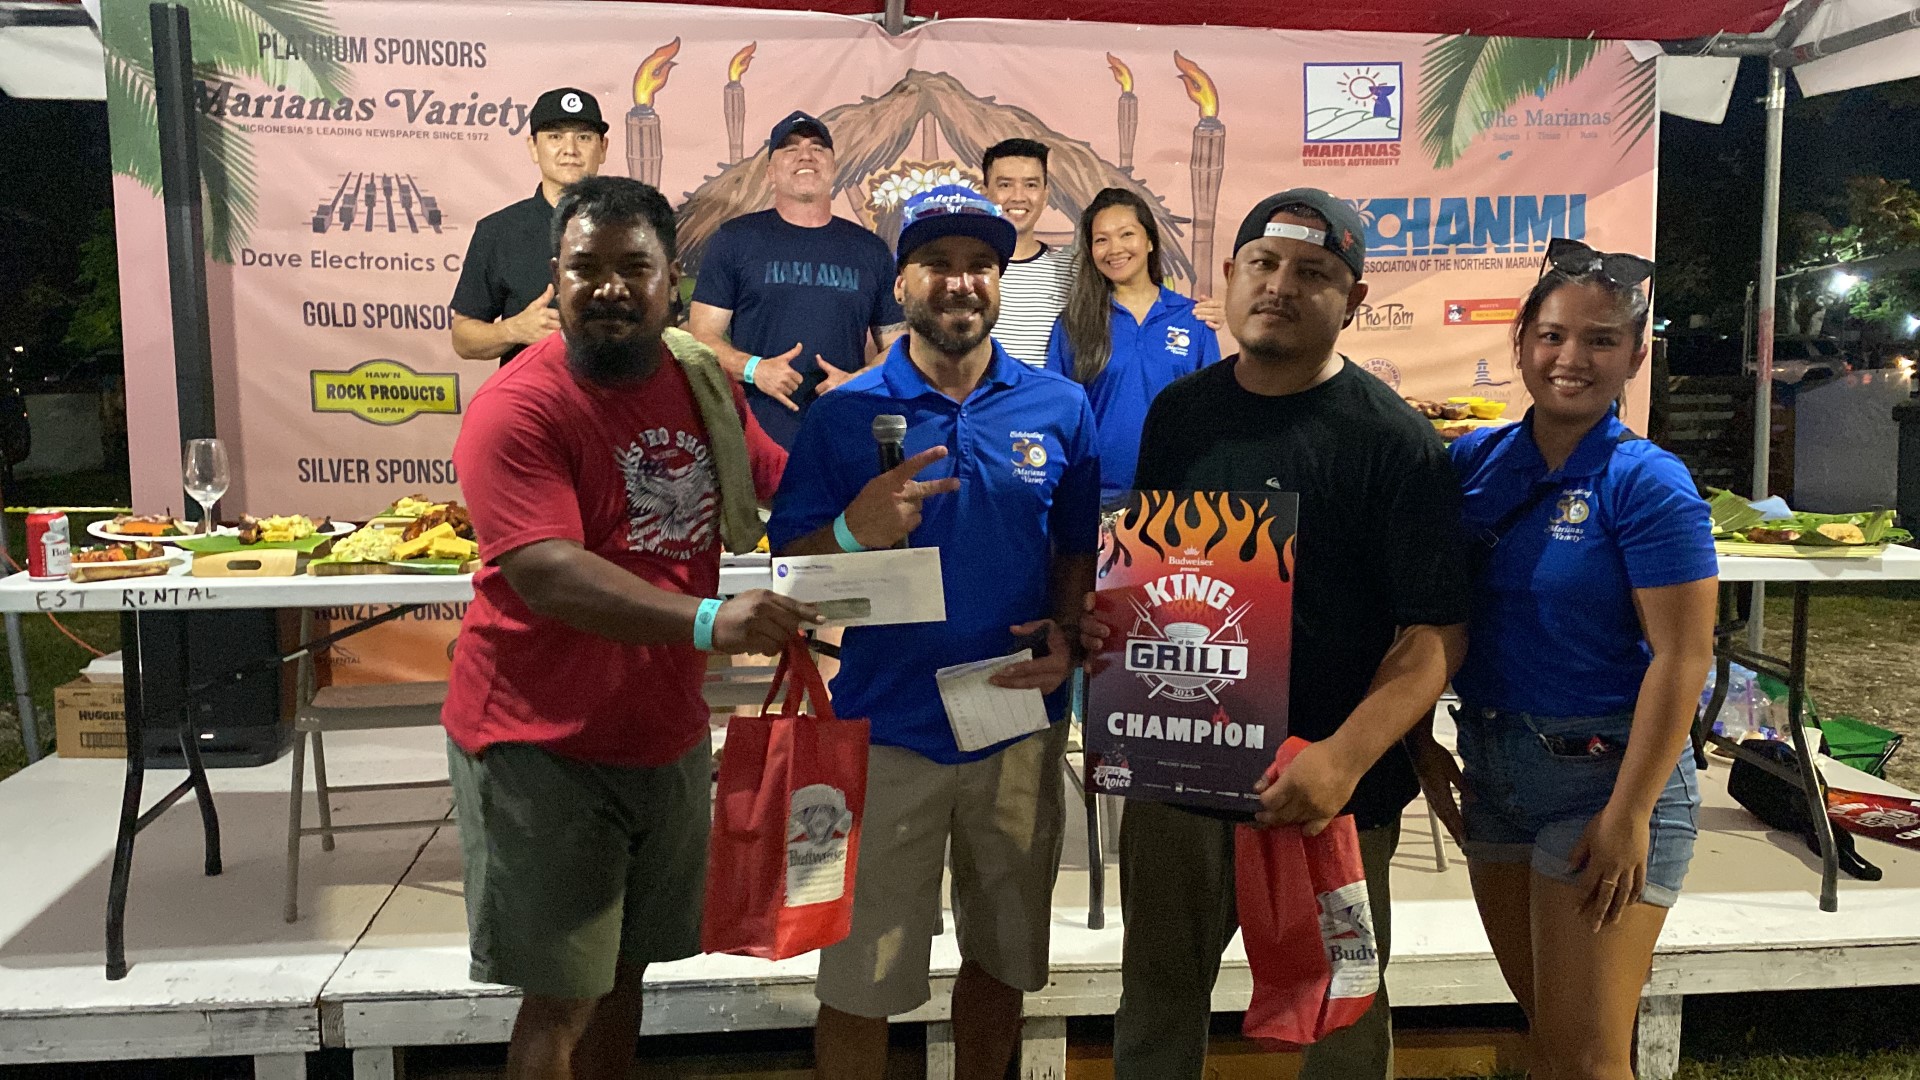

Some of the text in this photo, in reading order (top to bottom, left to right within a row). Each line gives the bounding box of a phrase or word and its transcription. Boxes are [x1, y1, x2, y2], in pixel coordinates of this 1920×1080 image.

[258, 33, 487, 69] PLATINUM SPONSORS
[196, 80, 531, 136] Marianas Variety
[1481, 108, 1612, 128] The Marianas
[316, 126, 362, 137] LEADING
[366, 129, 430, 140] NEWSPAPER
[433, 131, 463, 141] SINCE
[467, 131, 489, 141] 1972
[1302, 143, 1401, 157] MARIANAS
[1303, 157, 1400, 167] VISITORS AUTHORITY
[241, 248, 302, 267] Dave
[310, 250, 436, 272] Electronics
[1363, 260, 1417, 274] SSOCIATION
[1419, 259, 1431, 272] OF
[1434, 259, 1451, 271] THE
[1453, 257, 1503, 271] NORTHERN
[302, 301, 357, 329] GOLD
[365, 371, 401, 379] HAW'N
[326, 384, 446, 402] ROCK PRODUCTS
[366, 406, 405, 414] SAIPAN
[298, 458, 371, 484] SILVER
[1168, 556, 1214, 566] Budweiser
[1144, 574, 1235, 610] KING
[1131, 644, 1242, 676] GRILL
[1173, 687, 1195, 698] 2023
[1107, 712, 1265, 750] CHAMPION
[1093, 772, 1132, 790] Choice
